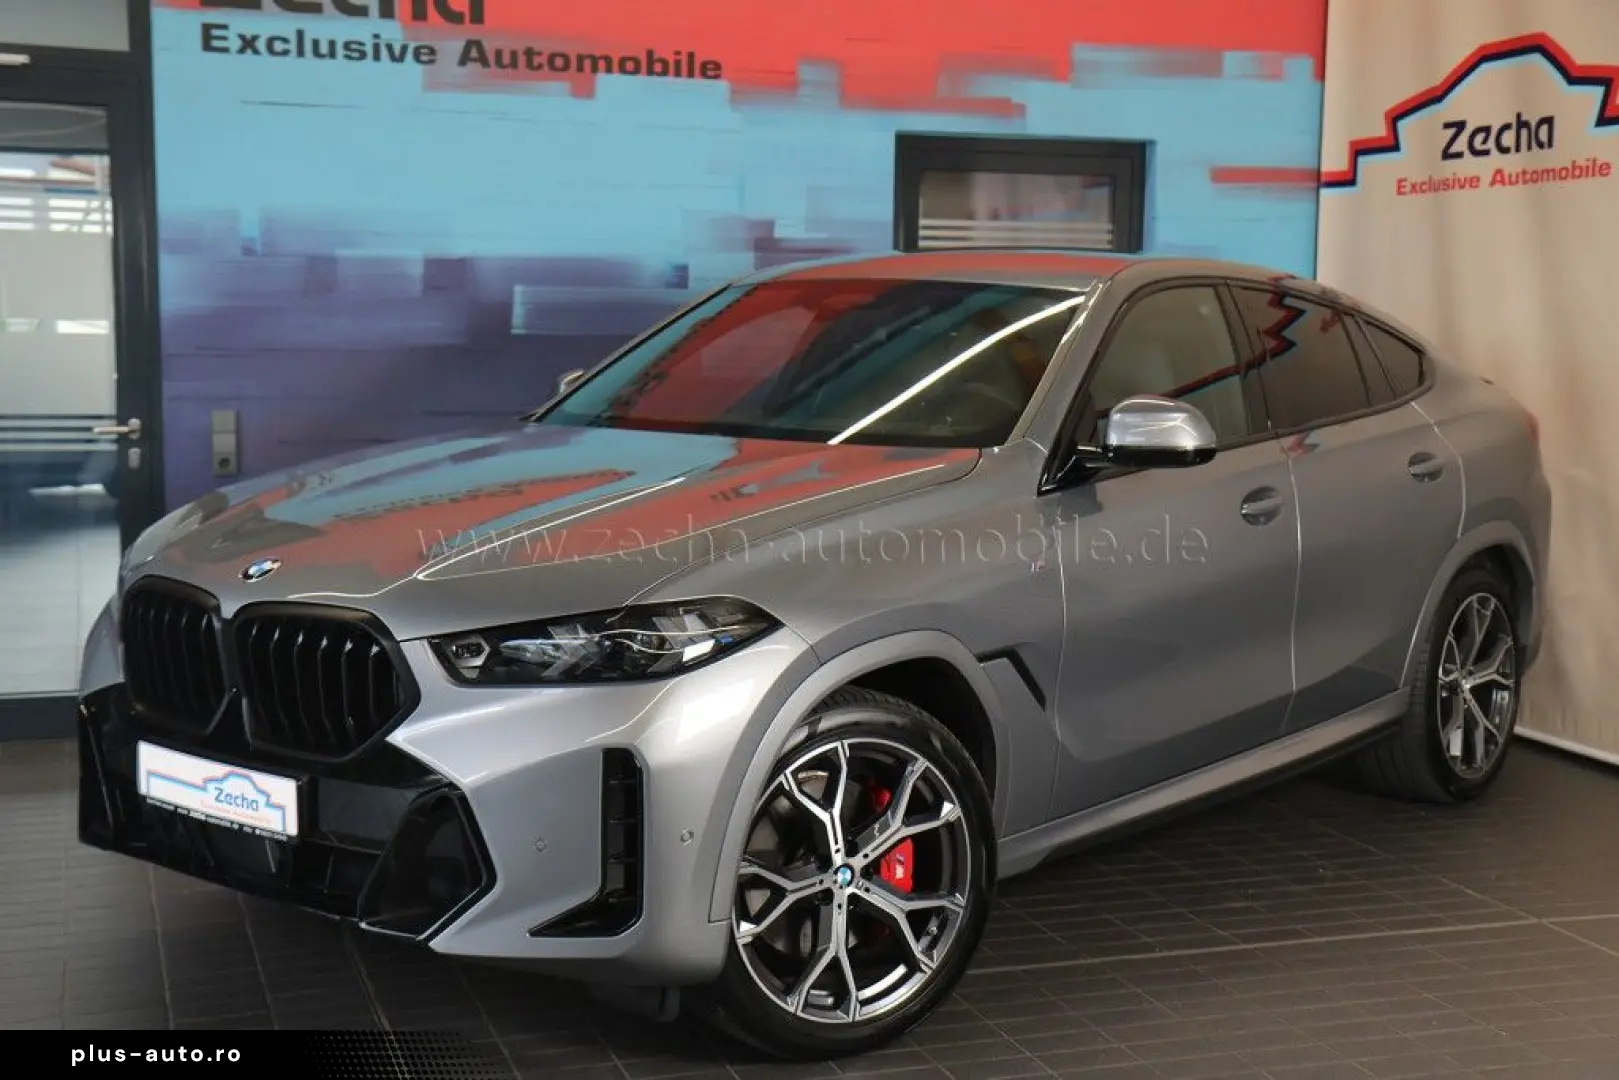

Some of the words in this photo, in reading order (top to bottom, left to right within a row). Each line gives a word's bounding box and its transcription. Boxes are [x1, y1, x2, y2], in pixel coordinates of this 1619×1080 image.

[201, 23, 437, 65] Exclusive
[457, 39, 723, 79] Automobile
[1441, 112, 1555, 161] Zecha
[1395, 173, 1481, 196] Exclusive
[1489, 157, 1612, 188] Automobile
[214, 786, 259, 812] Zecha
